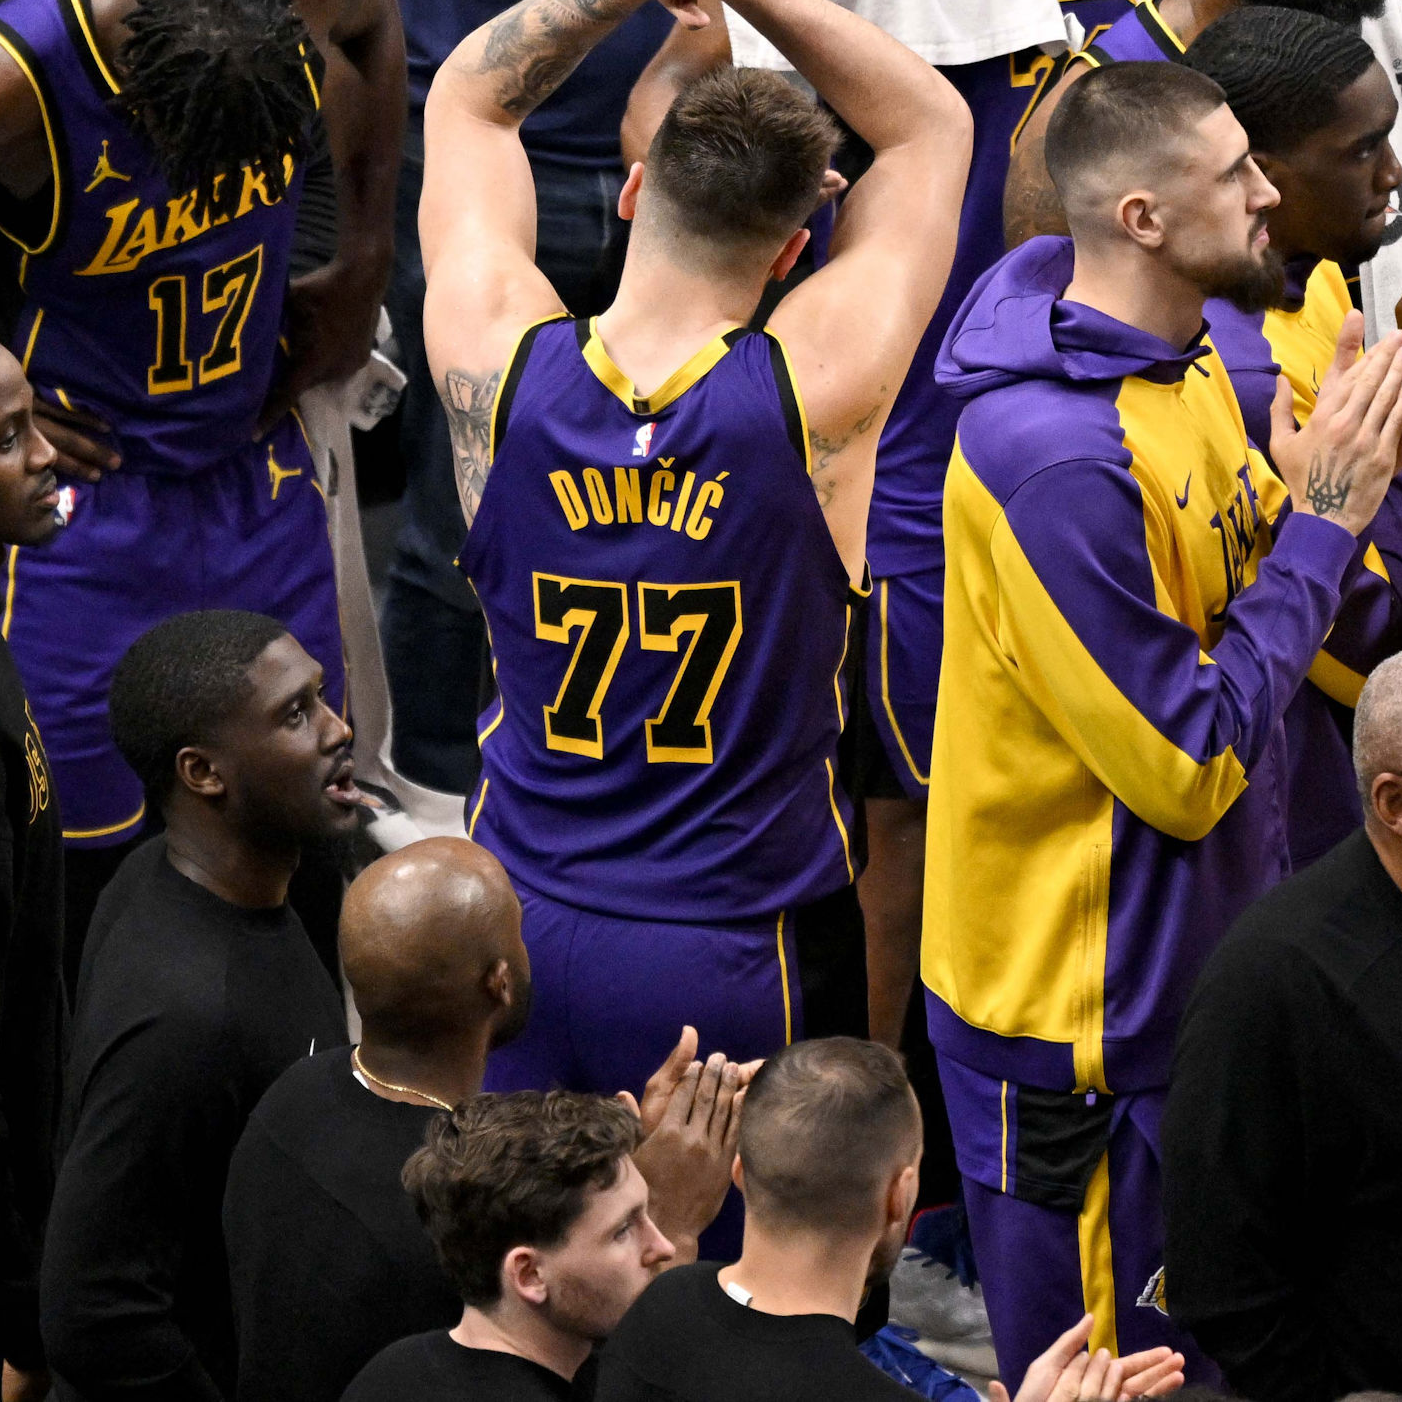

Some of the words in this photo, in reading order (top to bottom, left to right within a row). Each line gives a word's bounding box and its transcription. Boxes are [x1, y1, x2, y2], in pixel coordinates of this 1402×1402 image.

[72, 152, 295, 276] LAKR
[148, 243, 264, 396] 17
[548, 456, 731, 541] DONČIĆ
[531, 570, 744, 766] 77
